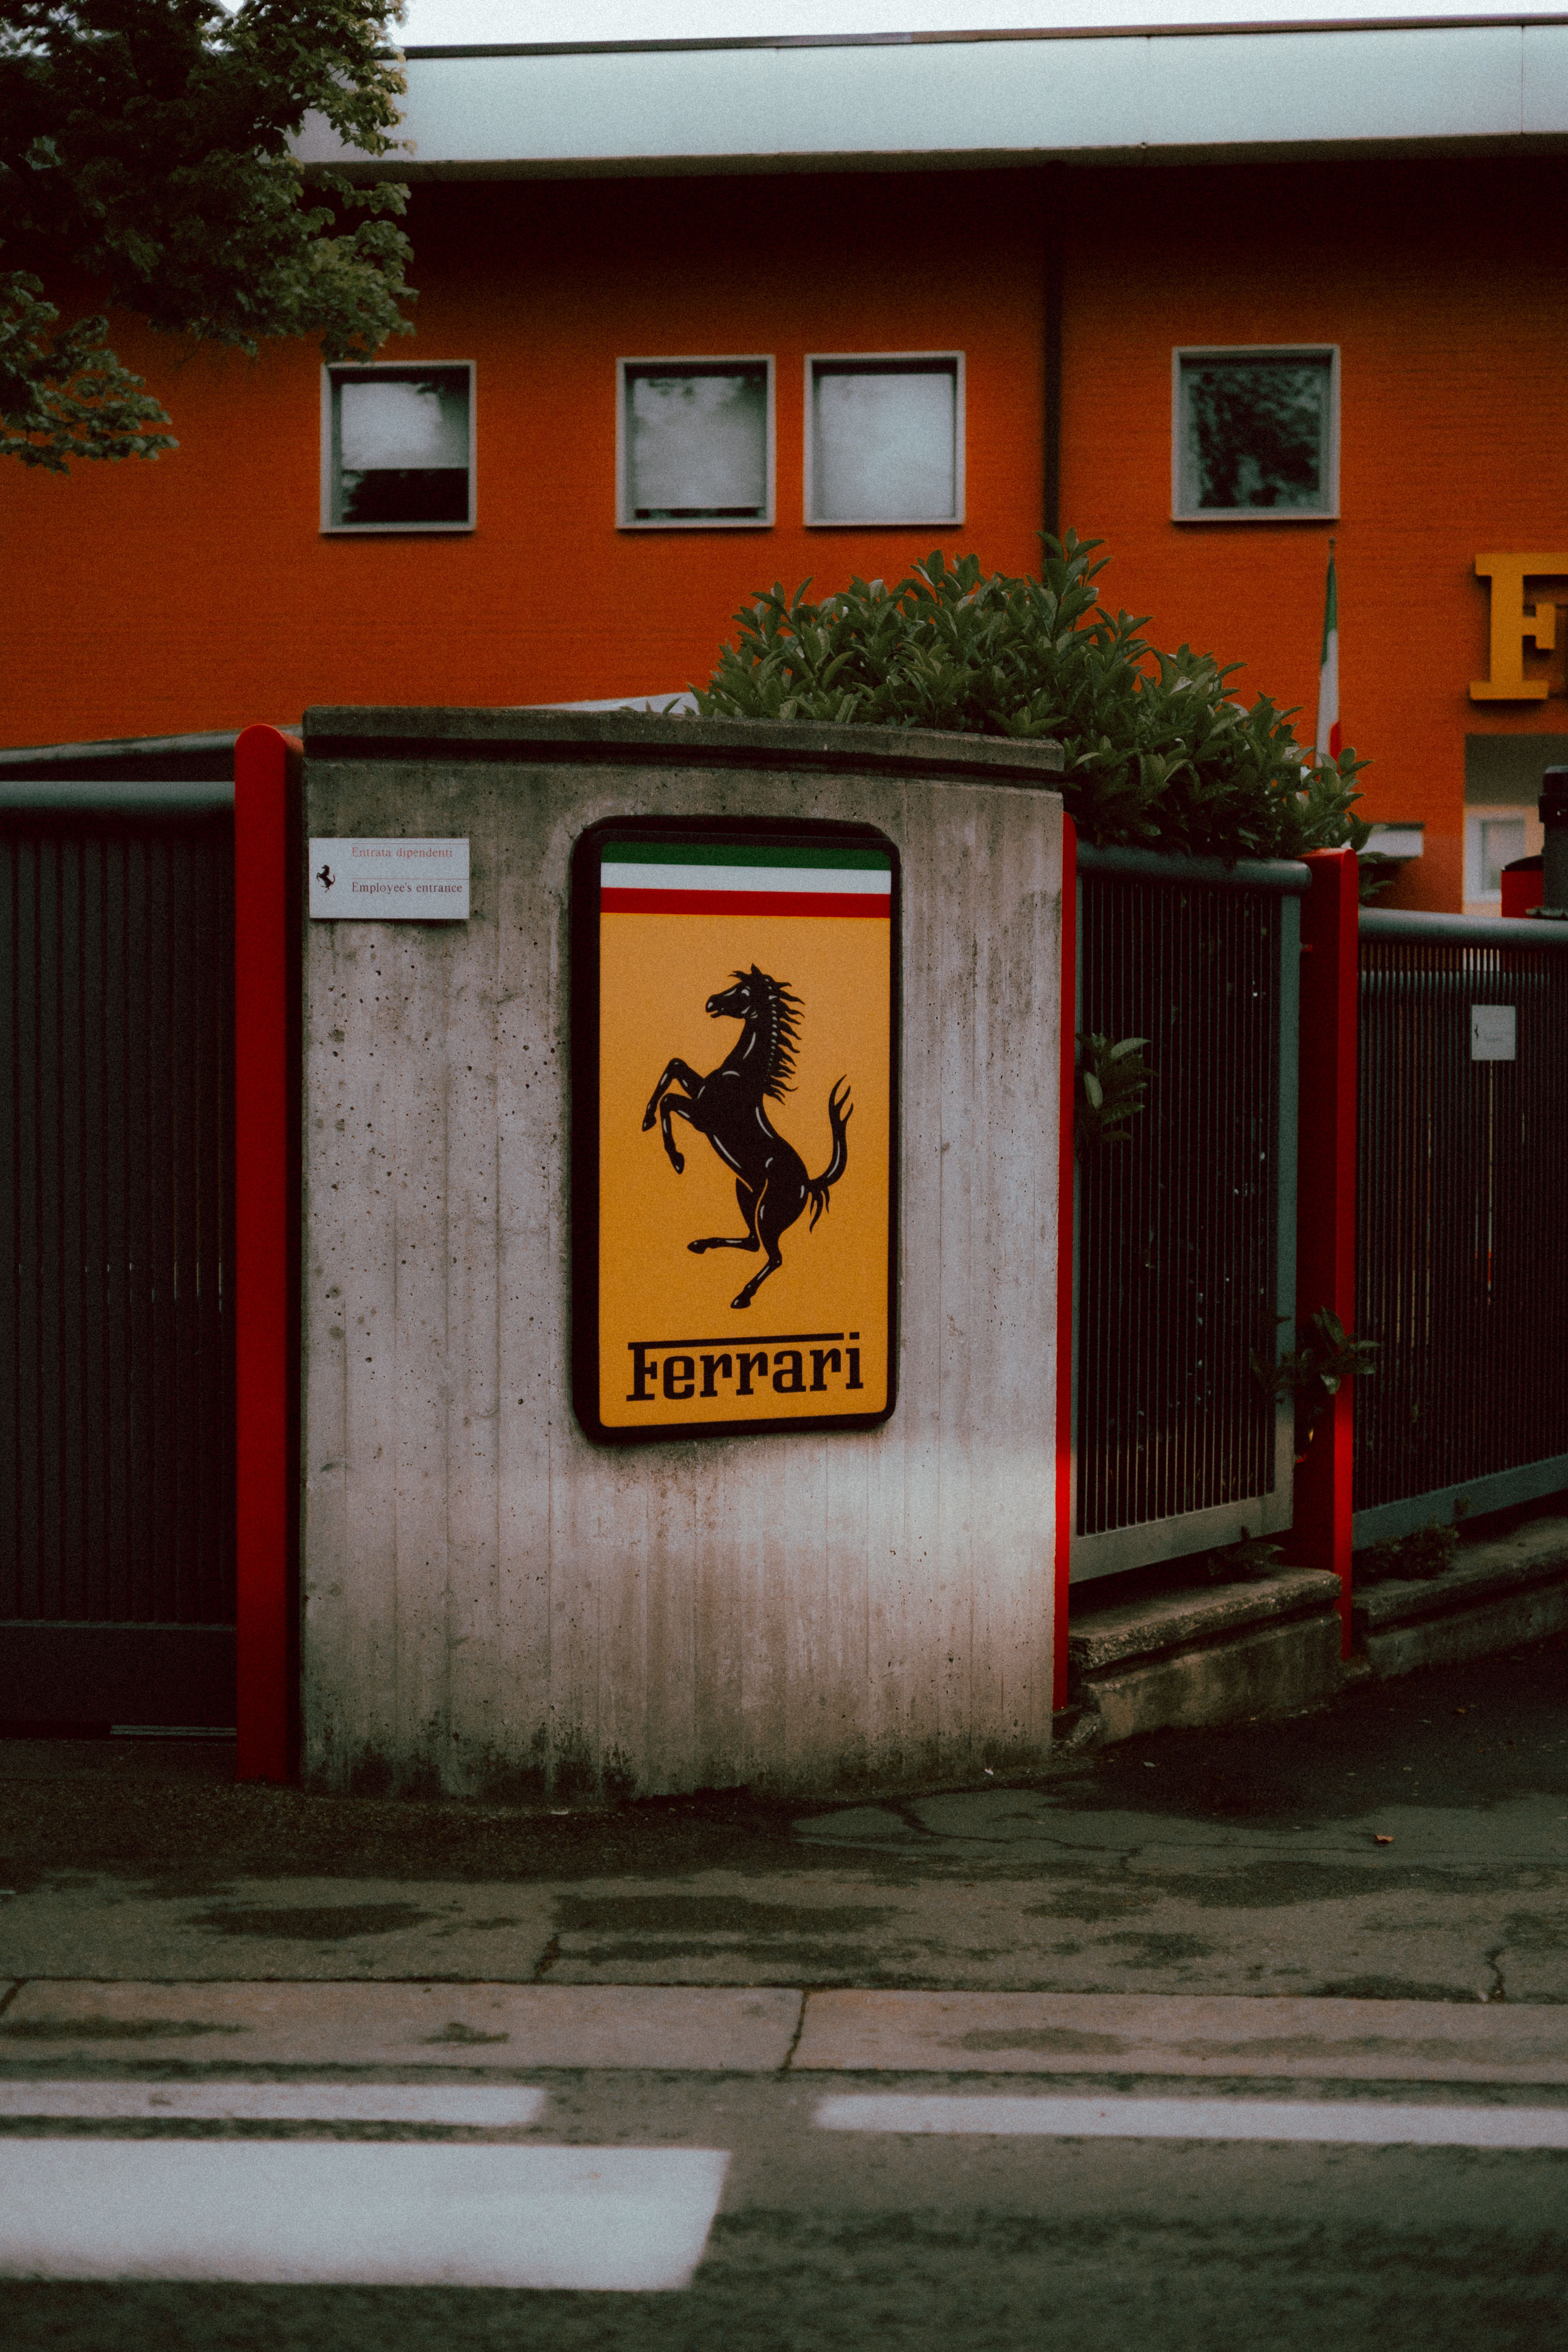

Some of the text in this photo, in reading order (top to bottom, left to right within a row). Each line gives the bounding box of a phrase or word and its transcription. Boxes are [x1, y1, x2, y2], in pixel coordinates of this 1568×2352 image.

[352, 847, 453, 859] Entrata dipendenti
[352, 882, 463, 894] Employee's entrance
[626, 1332, 863, 1402] Ferrari
